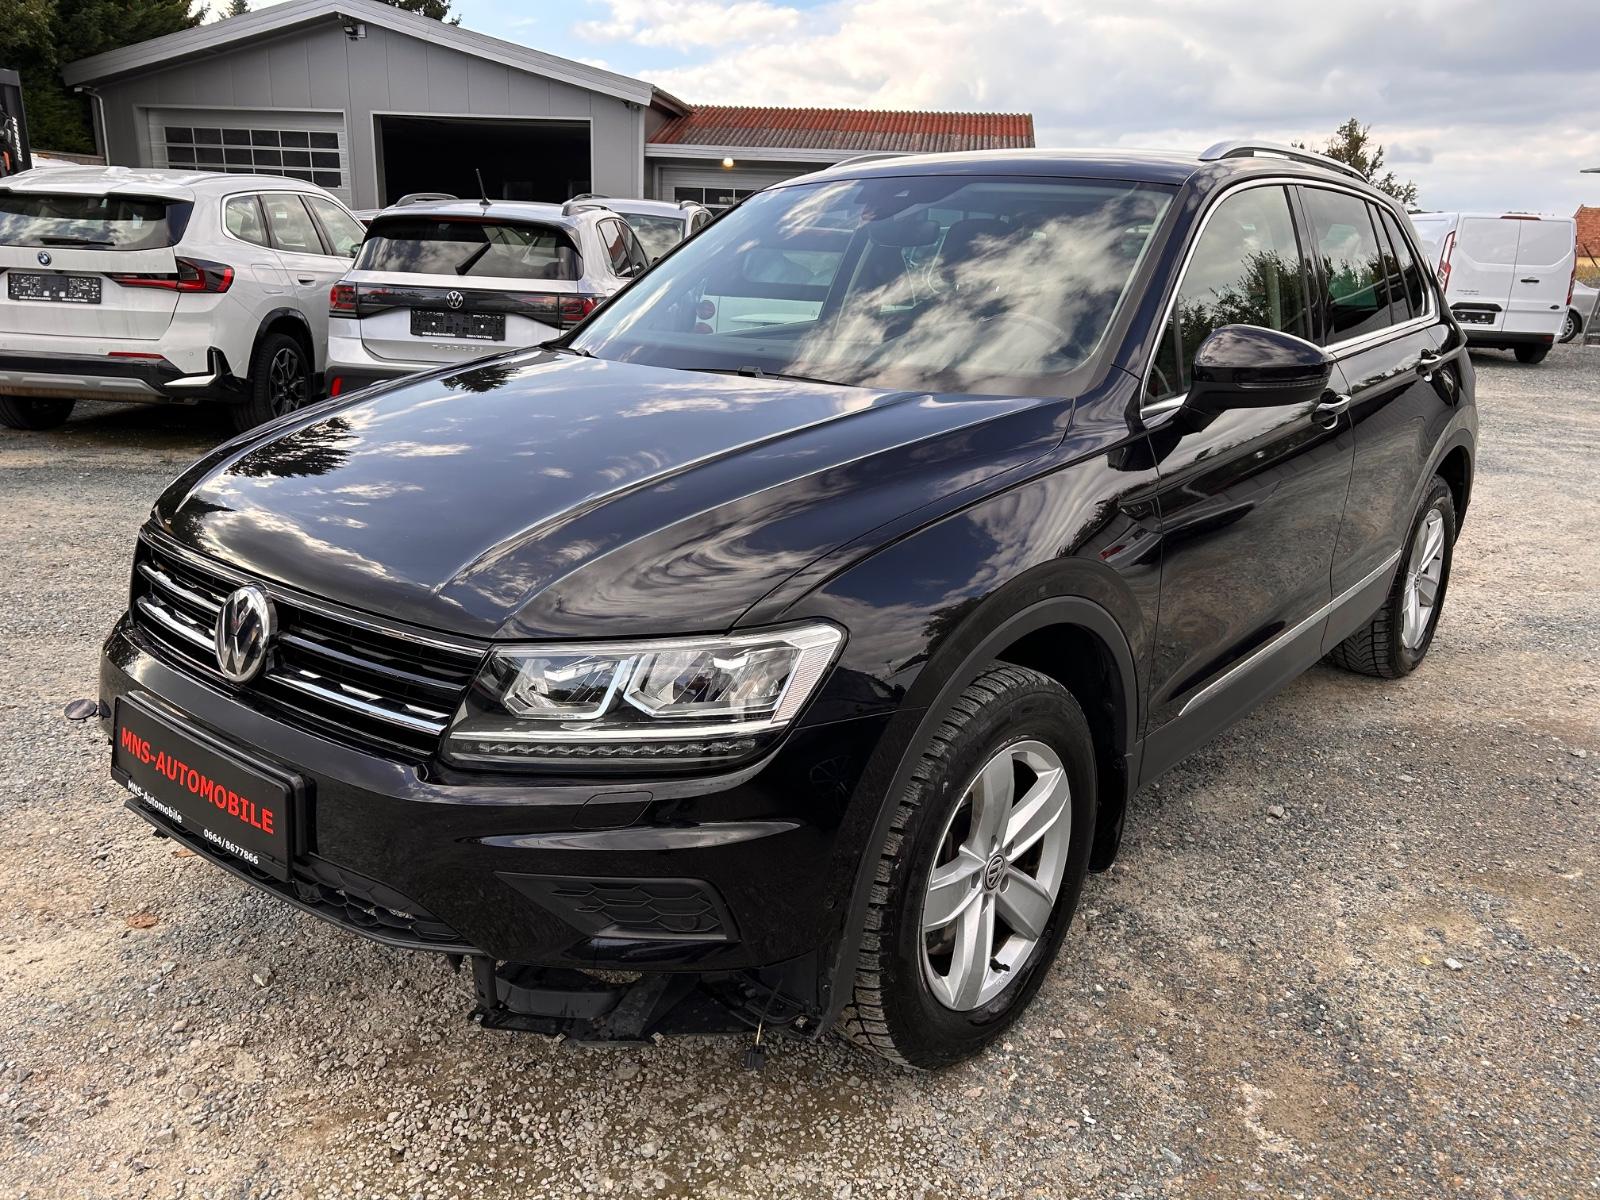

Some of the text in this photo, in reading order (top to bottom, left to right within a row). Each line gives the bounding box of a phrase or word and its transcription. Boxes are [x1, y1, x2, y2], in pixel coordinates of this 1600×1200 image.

[121, 727, 274, 835] MNS-AUTOMOBILE
[127, 779, 182, 824] MNS-Automobile
[203, 828, 259, 865] 0664/8677866
